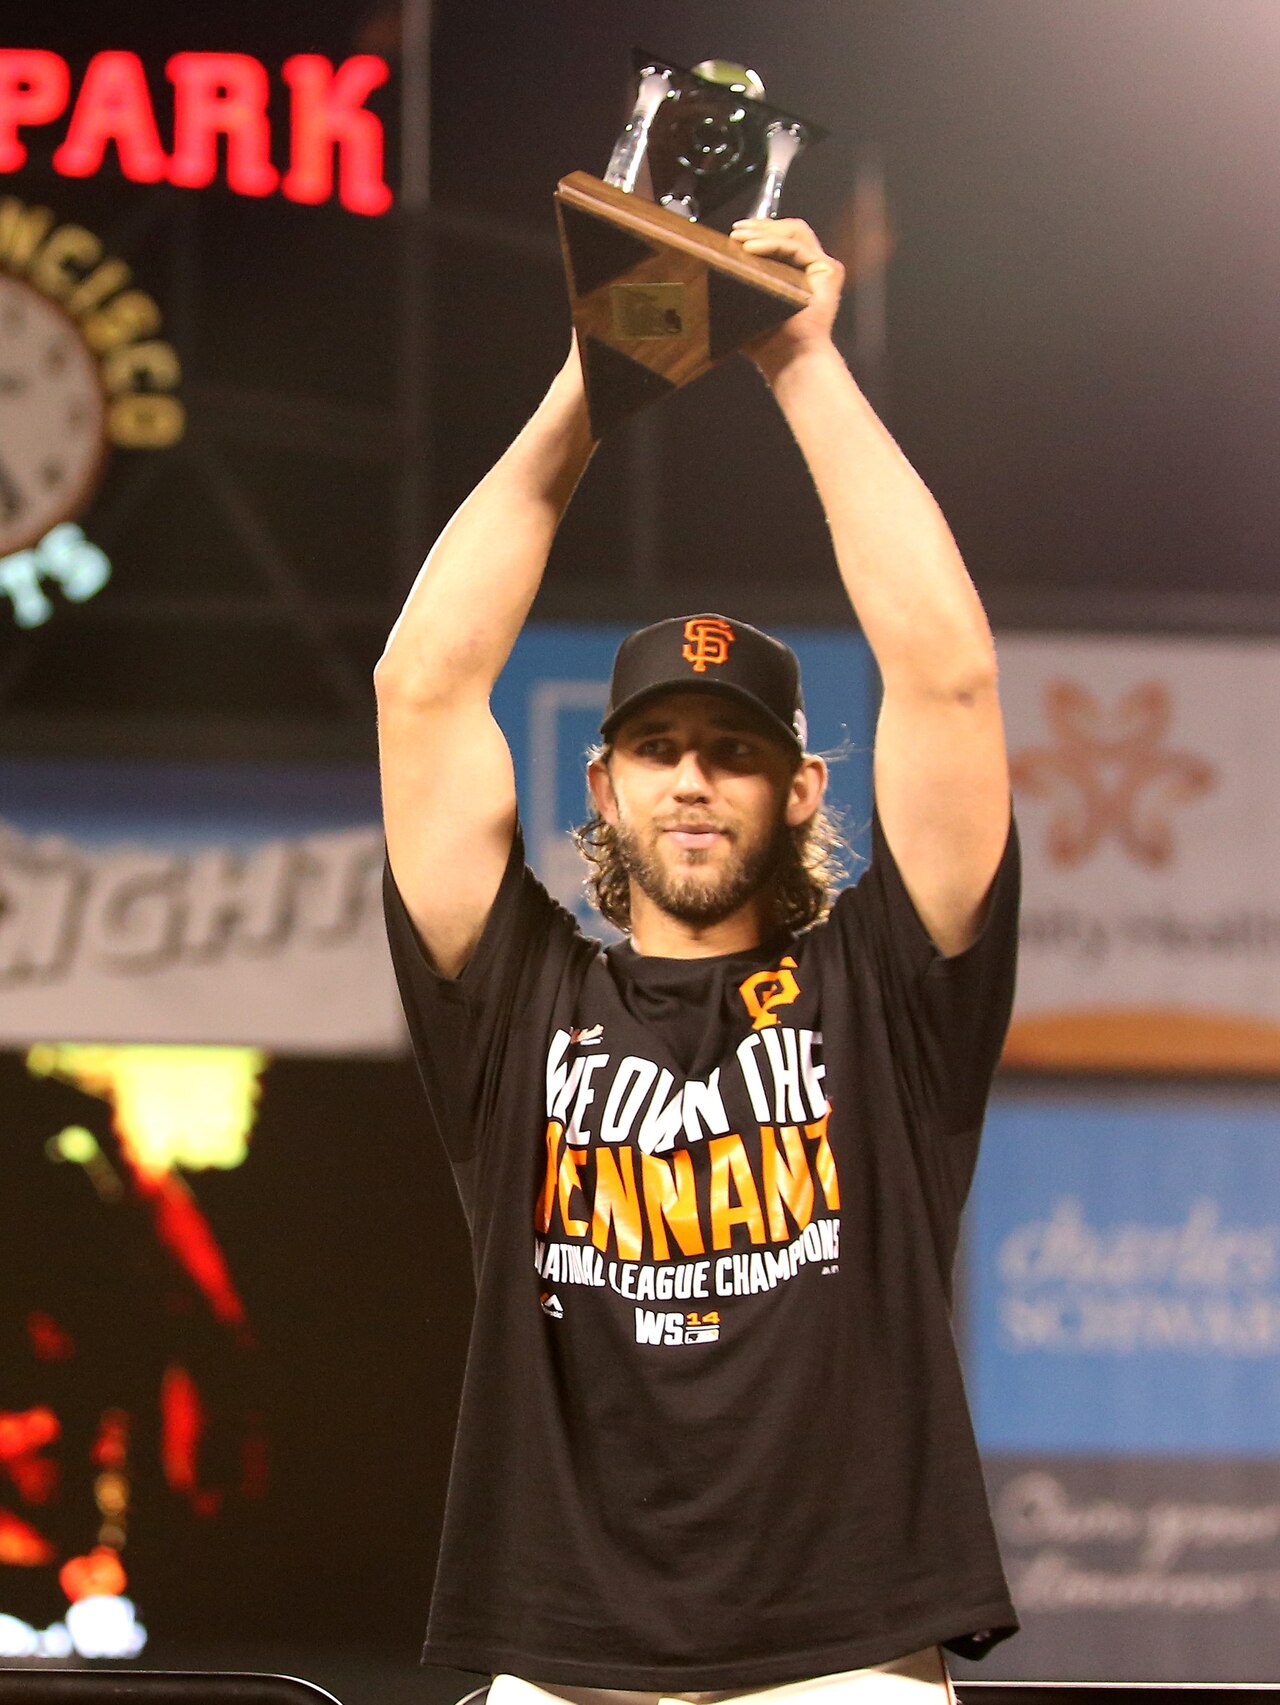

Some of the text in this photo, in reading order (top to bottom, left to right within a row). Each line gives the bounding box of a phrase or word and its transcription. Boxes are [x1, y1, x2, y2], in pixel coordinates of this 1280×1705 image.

[545, 1027, 830, 1155] WE OWN THE
[534, 1218, 841, 1301] NATINAL LEAGUE CHAMPIONS
[635, 1307, 720, 1345] WS 14
